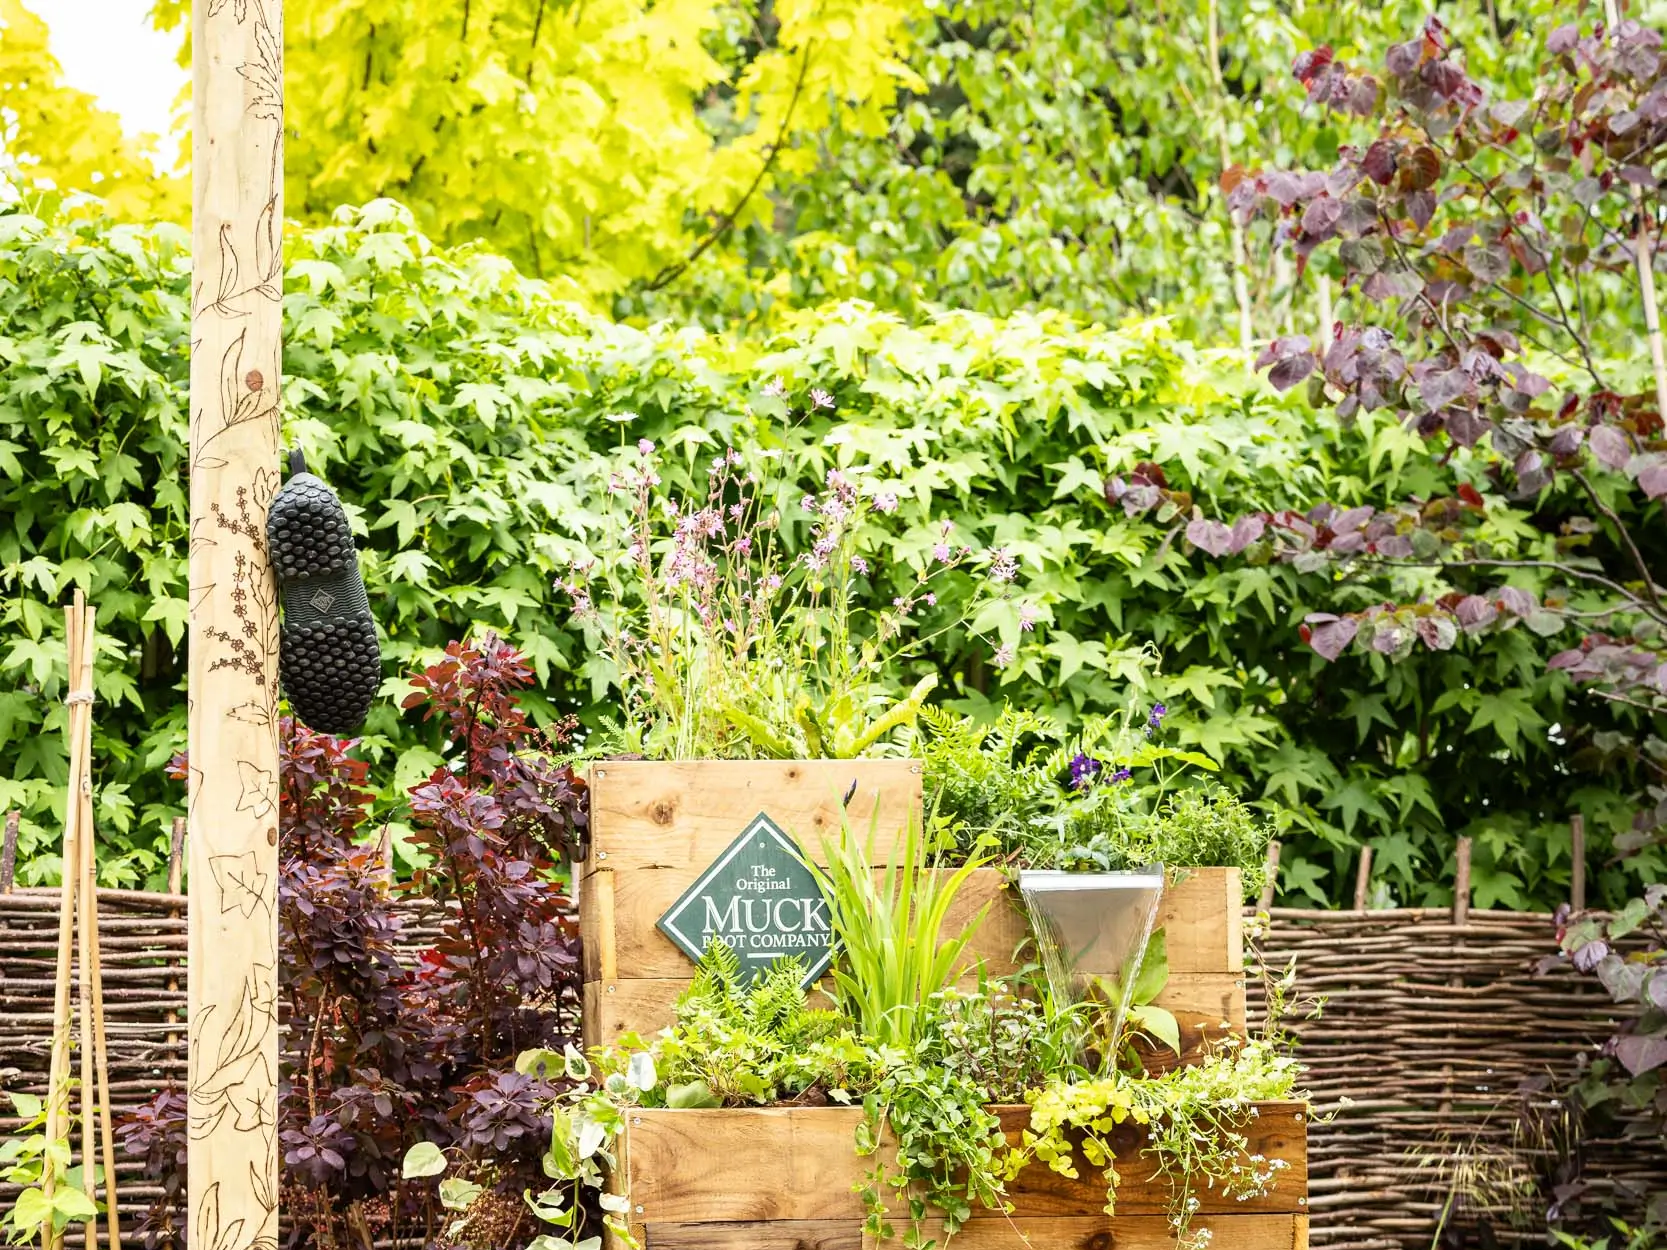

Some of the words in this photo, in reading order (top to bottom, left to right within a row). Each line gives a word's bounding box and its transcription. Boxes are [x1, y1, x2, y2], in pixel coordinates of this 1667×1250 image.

[750, 865, 776, 877] The
[736, 877, 791, 893] Original
[701, 895, 831, 933] MUCK
[750, 933, 831, 948] COMPANY
